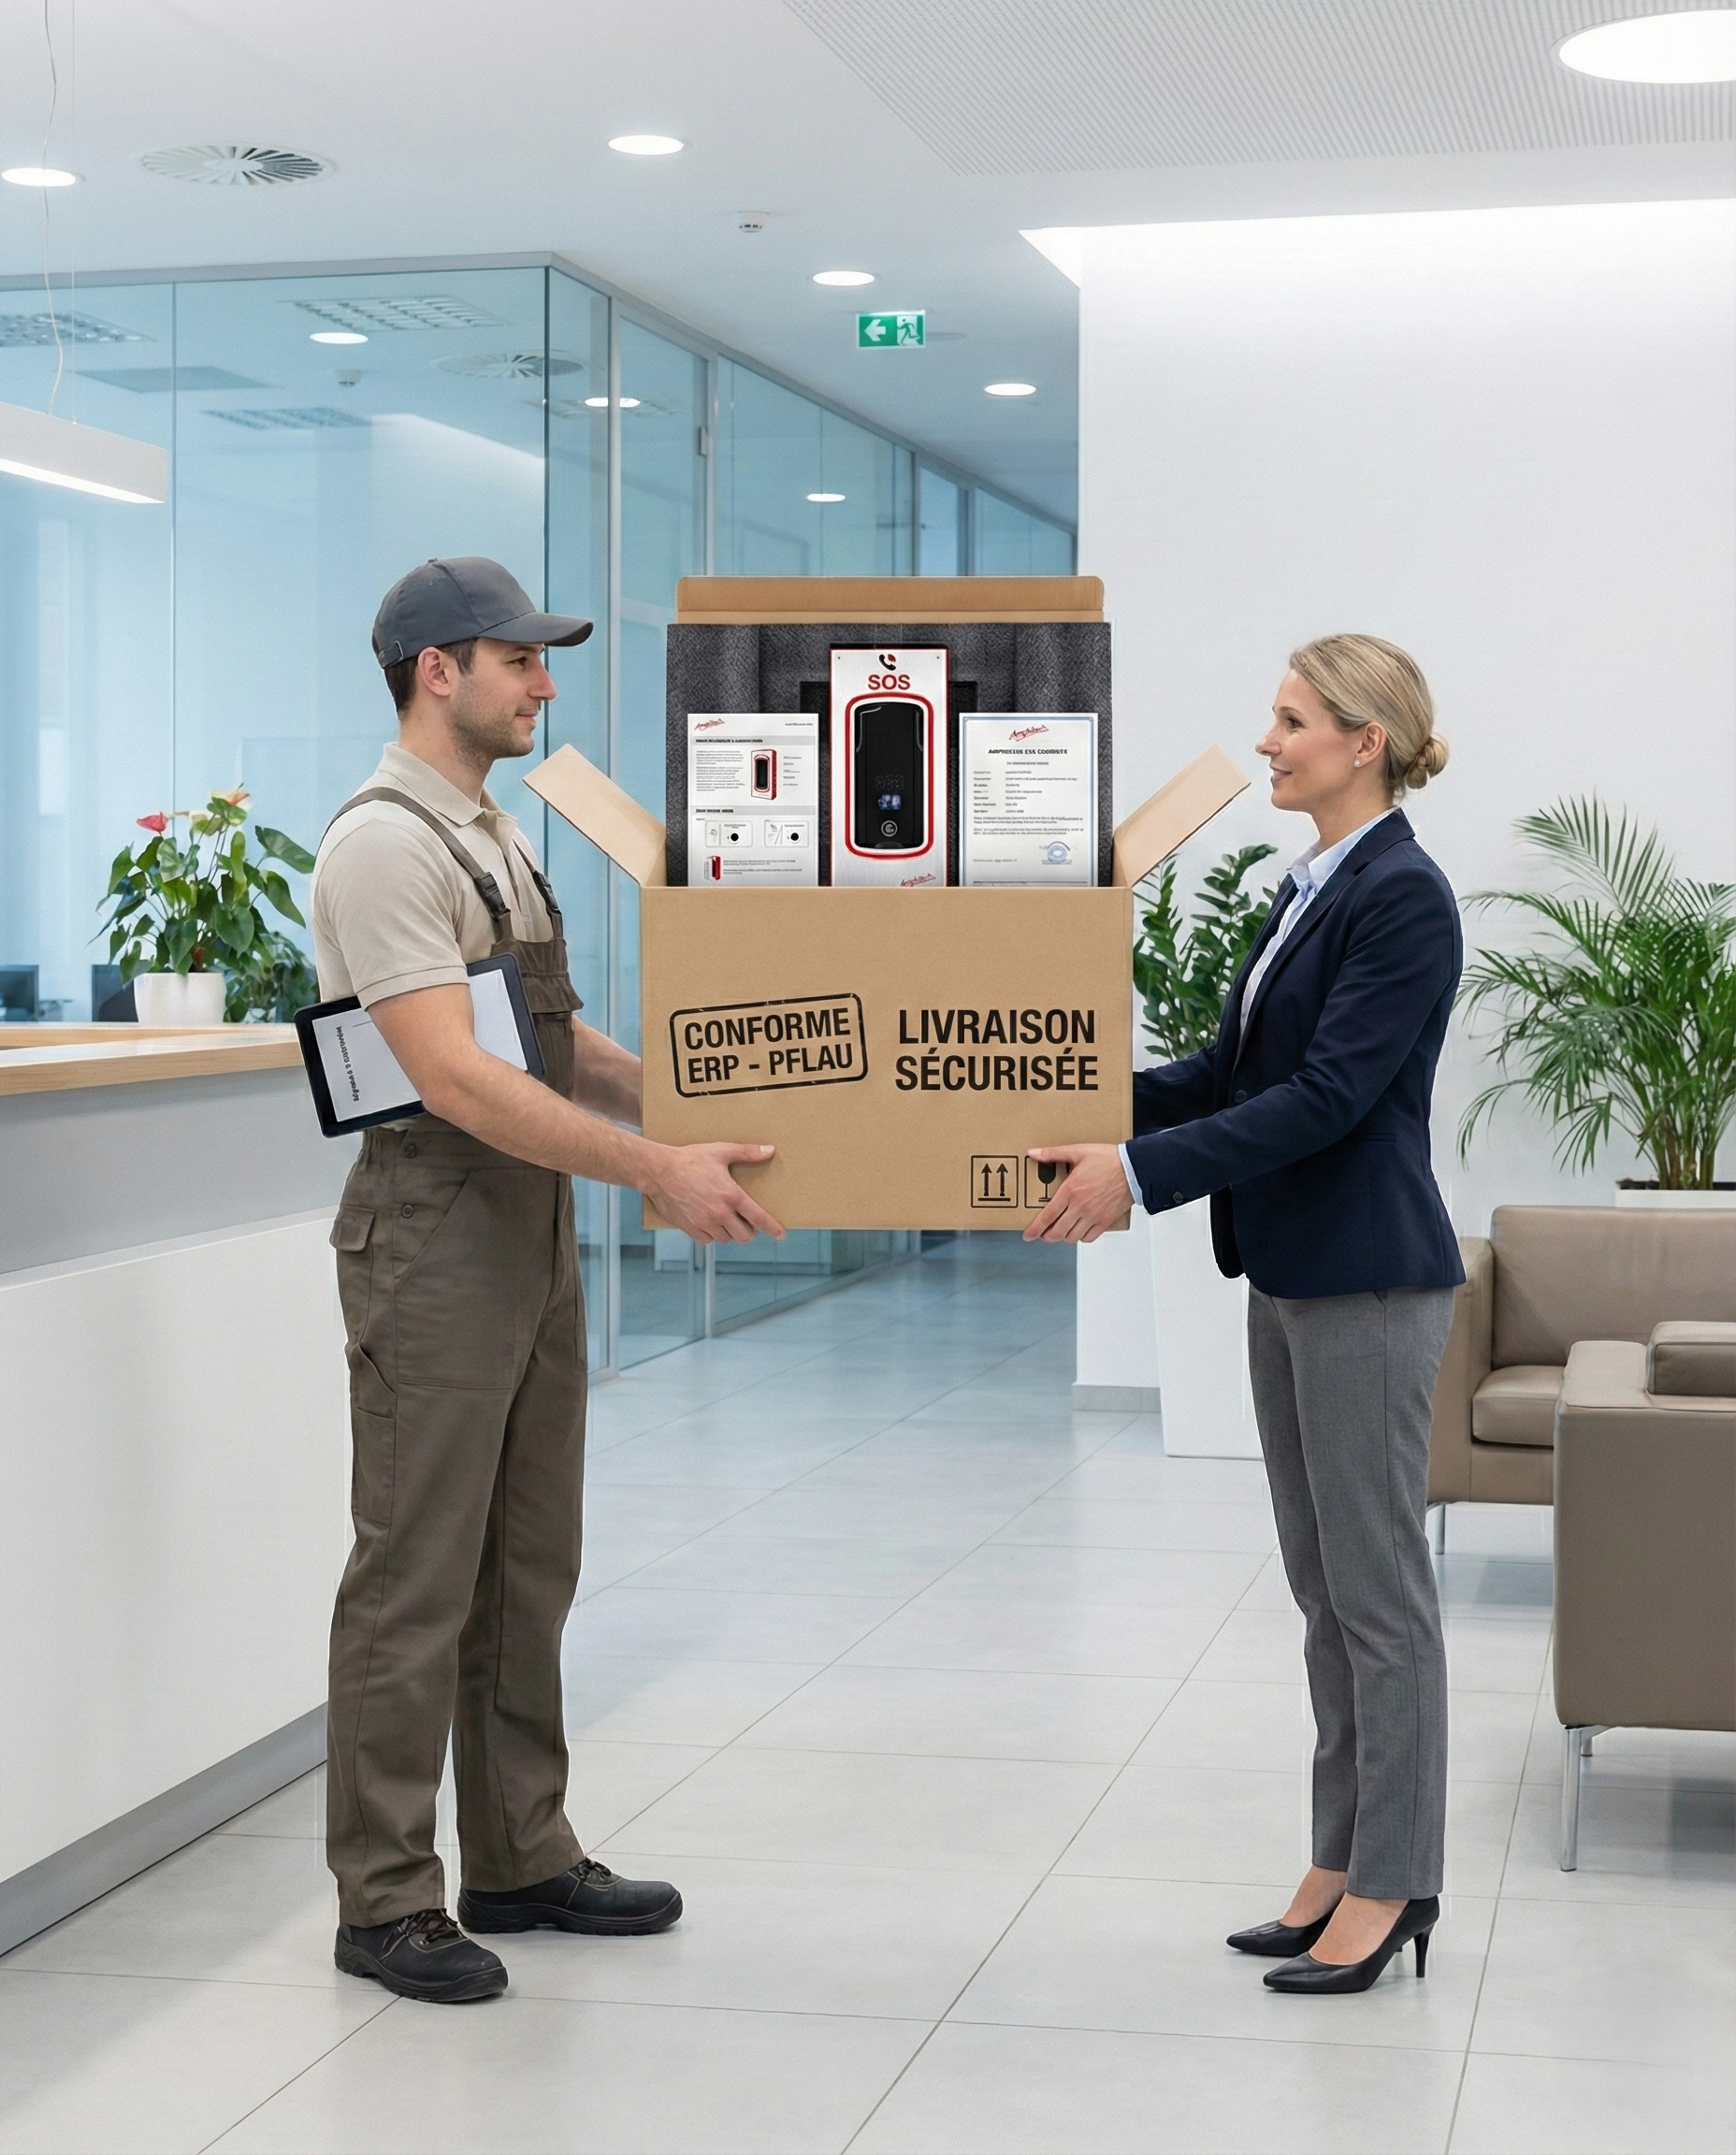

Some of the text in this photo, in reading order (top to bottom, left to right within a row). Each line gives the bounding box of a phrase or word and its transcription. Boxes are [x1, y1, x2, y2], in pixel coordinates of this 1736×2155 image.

[867, 673, 911, 691] SOS
[684, 1007, 851, 1050] CONFORME
[899, 1008, 1095, 1044] LIVRAISON
[687, 1054, 740, 1084] ERP
[768, 1042, 853, 1076] PFLAU
[895, 1047, 1099, 1091] SÉCURISÉE
